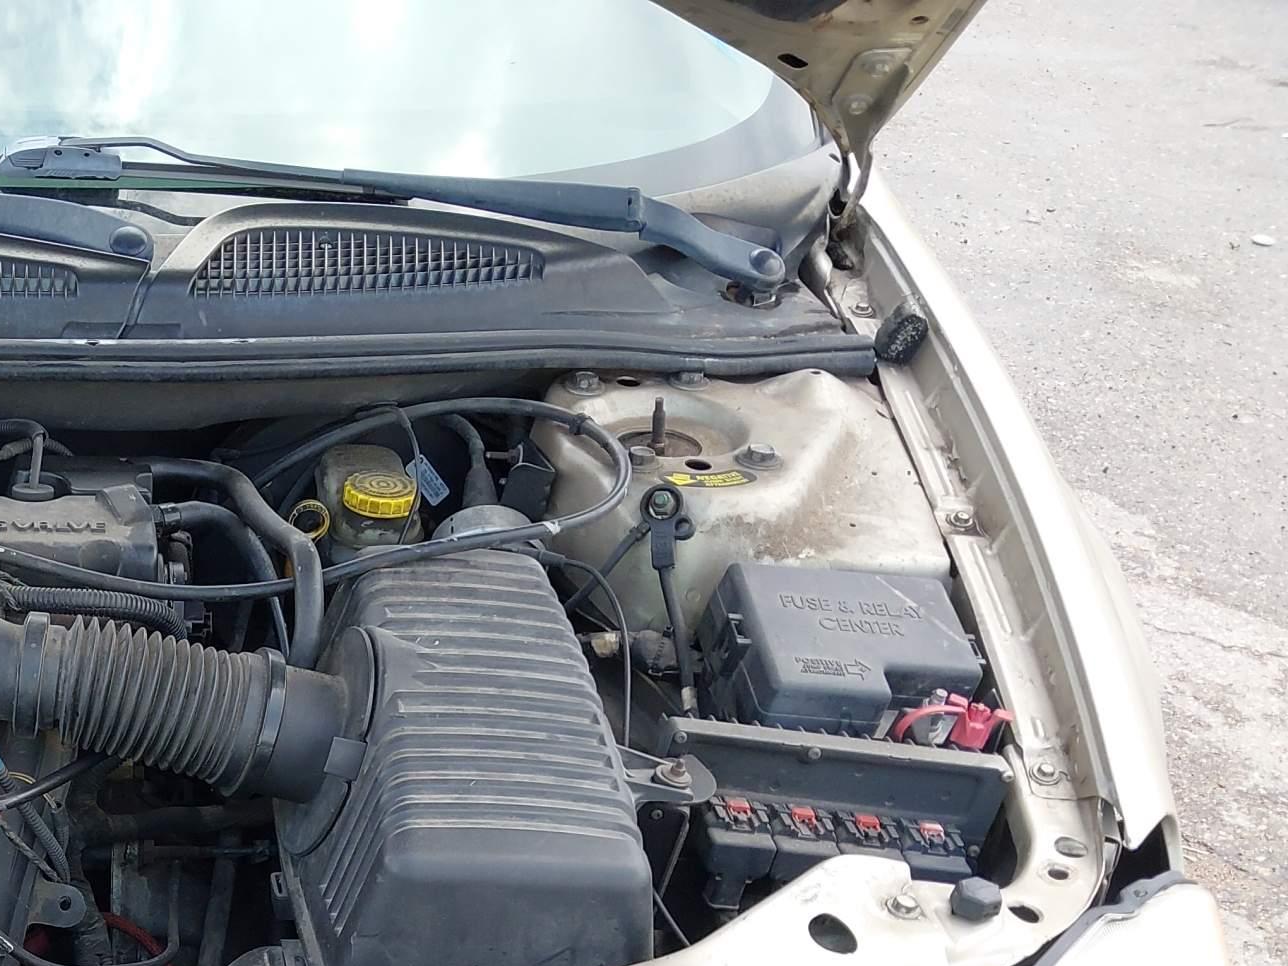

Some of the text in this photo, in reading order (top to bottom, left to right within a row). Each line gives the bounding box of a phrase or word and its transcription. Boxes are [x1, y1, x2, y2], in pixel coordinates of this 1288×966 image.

[779, 594, 923, 619] FUSE & RELAY
[818, 617, 905, 637] CENTER
